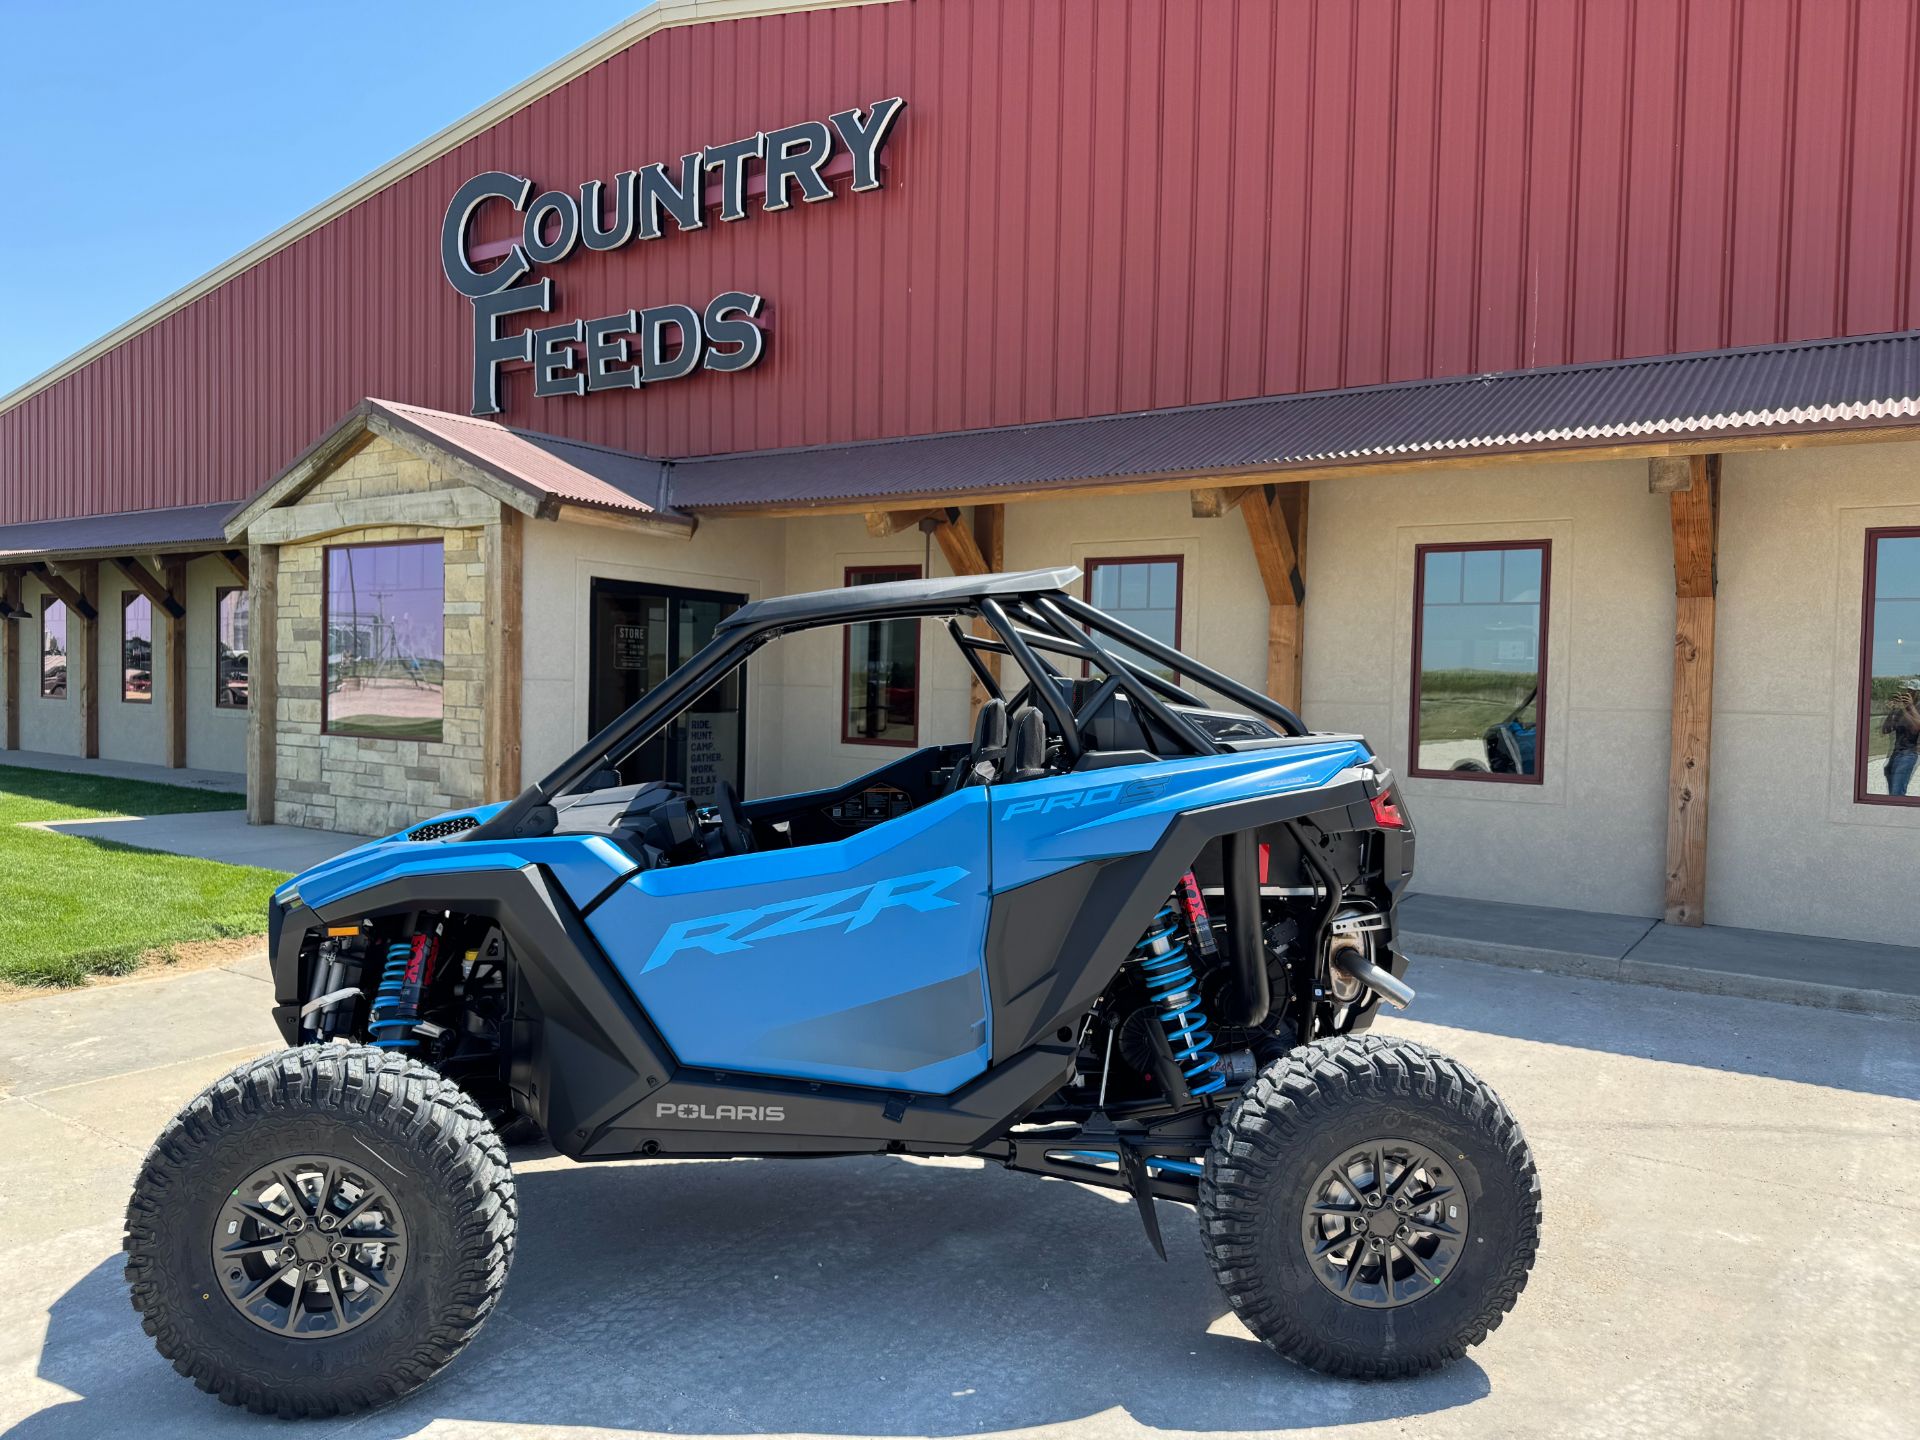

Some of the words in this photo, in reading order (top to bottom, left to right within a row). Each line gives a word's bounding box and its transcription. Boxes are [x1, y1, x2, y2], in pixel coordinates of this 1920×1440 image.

[440, 97, 906, 299] COUNTRY
[469, 276, 769, 416] FEEDS
[619, 627, 644, 640] STORE
[690, 731, 714, 741] HUNT.
[690, 786, 715, 797] REPEA
[640, 865, 971, 974] RZR
[656, 1102, 785, 1121] POLARIS
